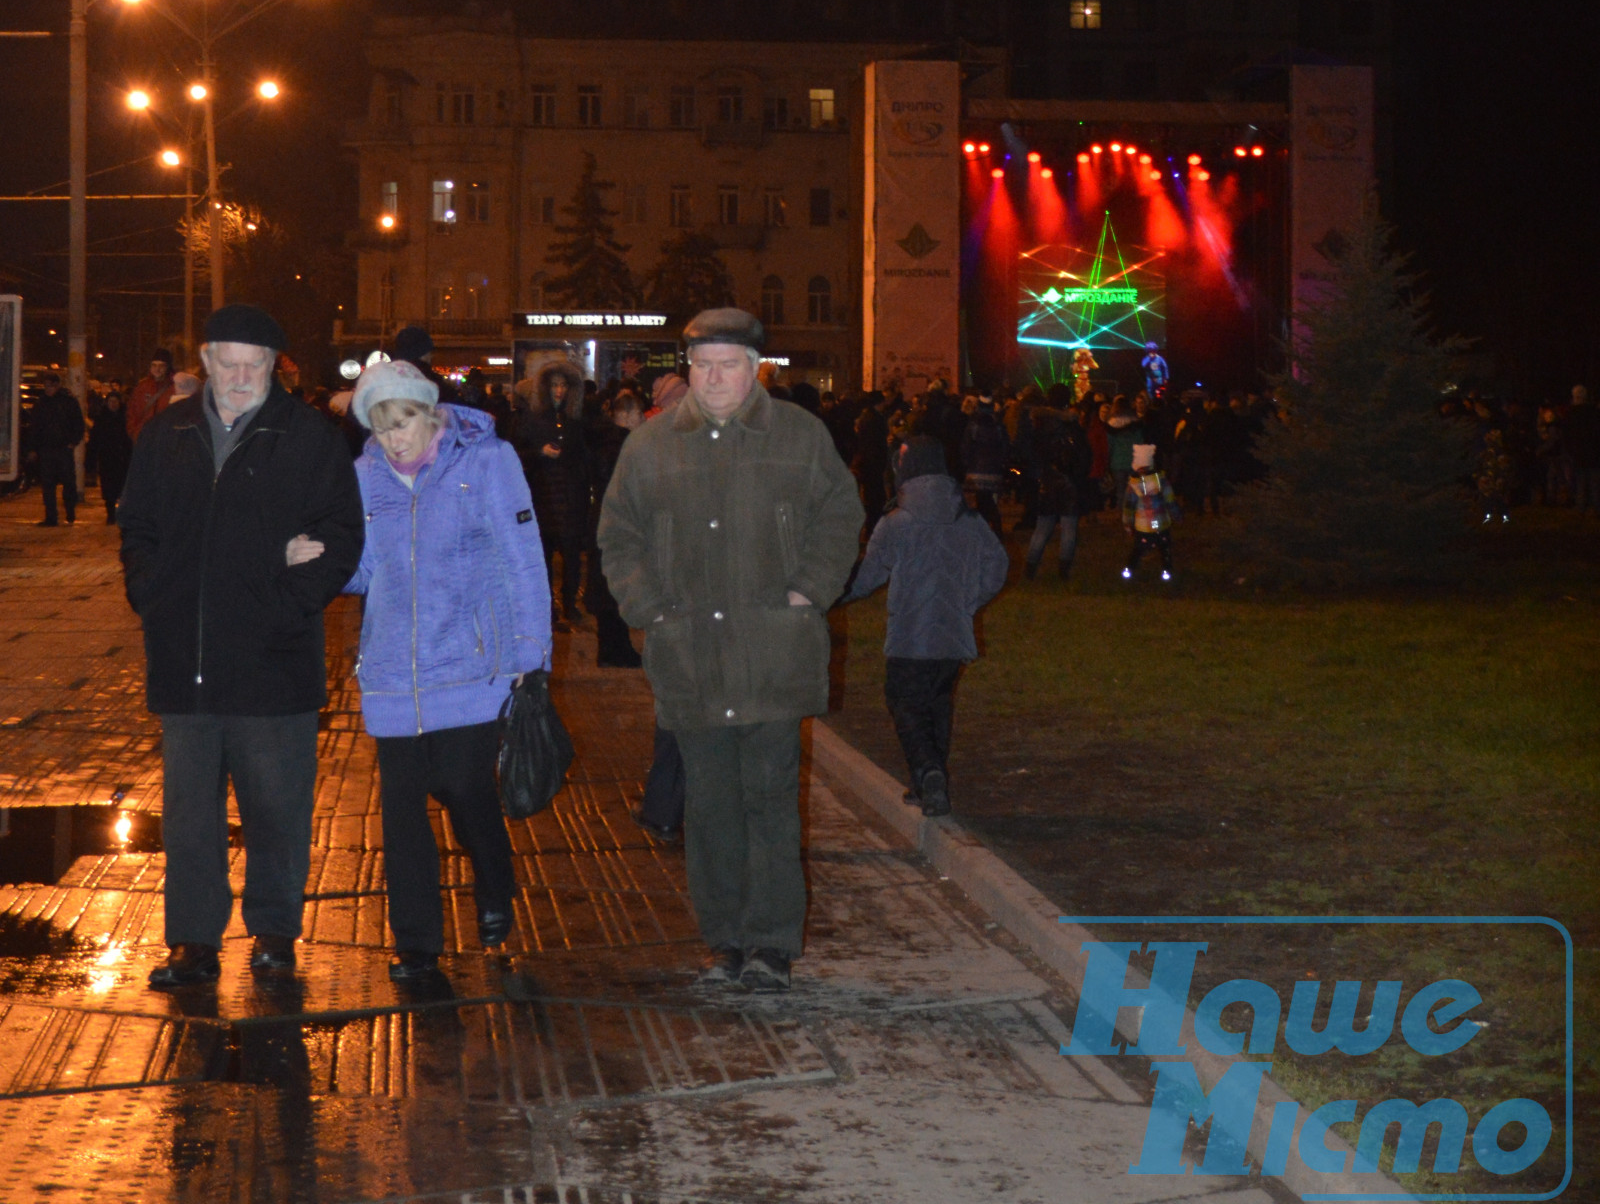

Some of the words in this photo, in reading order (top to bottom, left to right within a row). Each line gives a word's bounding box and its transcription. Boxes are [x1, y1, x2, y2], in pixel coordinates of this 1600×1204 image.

[526, 314, 563, 325] ТЕАТР
[563, 314, 603, 325] ОПЕРИ
[605, 315, 622, 325] ТА
[623, 315, 667, 326] БАЛЕТУ
